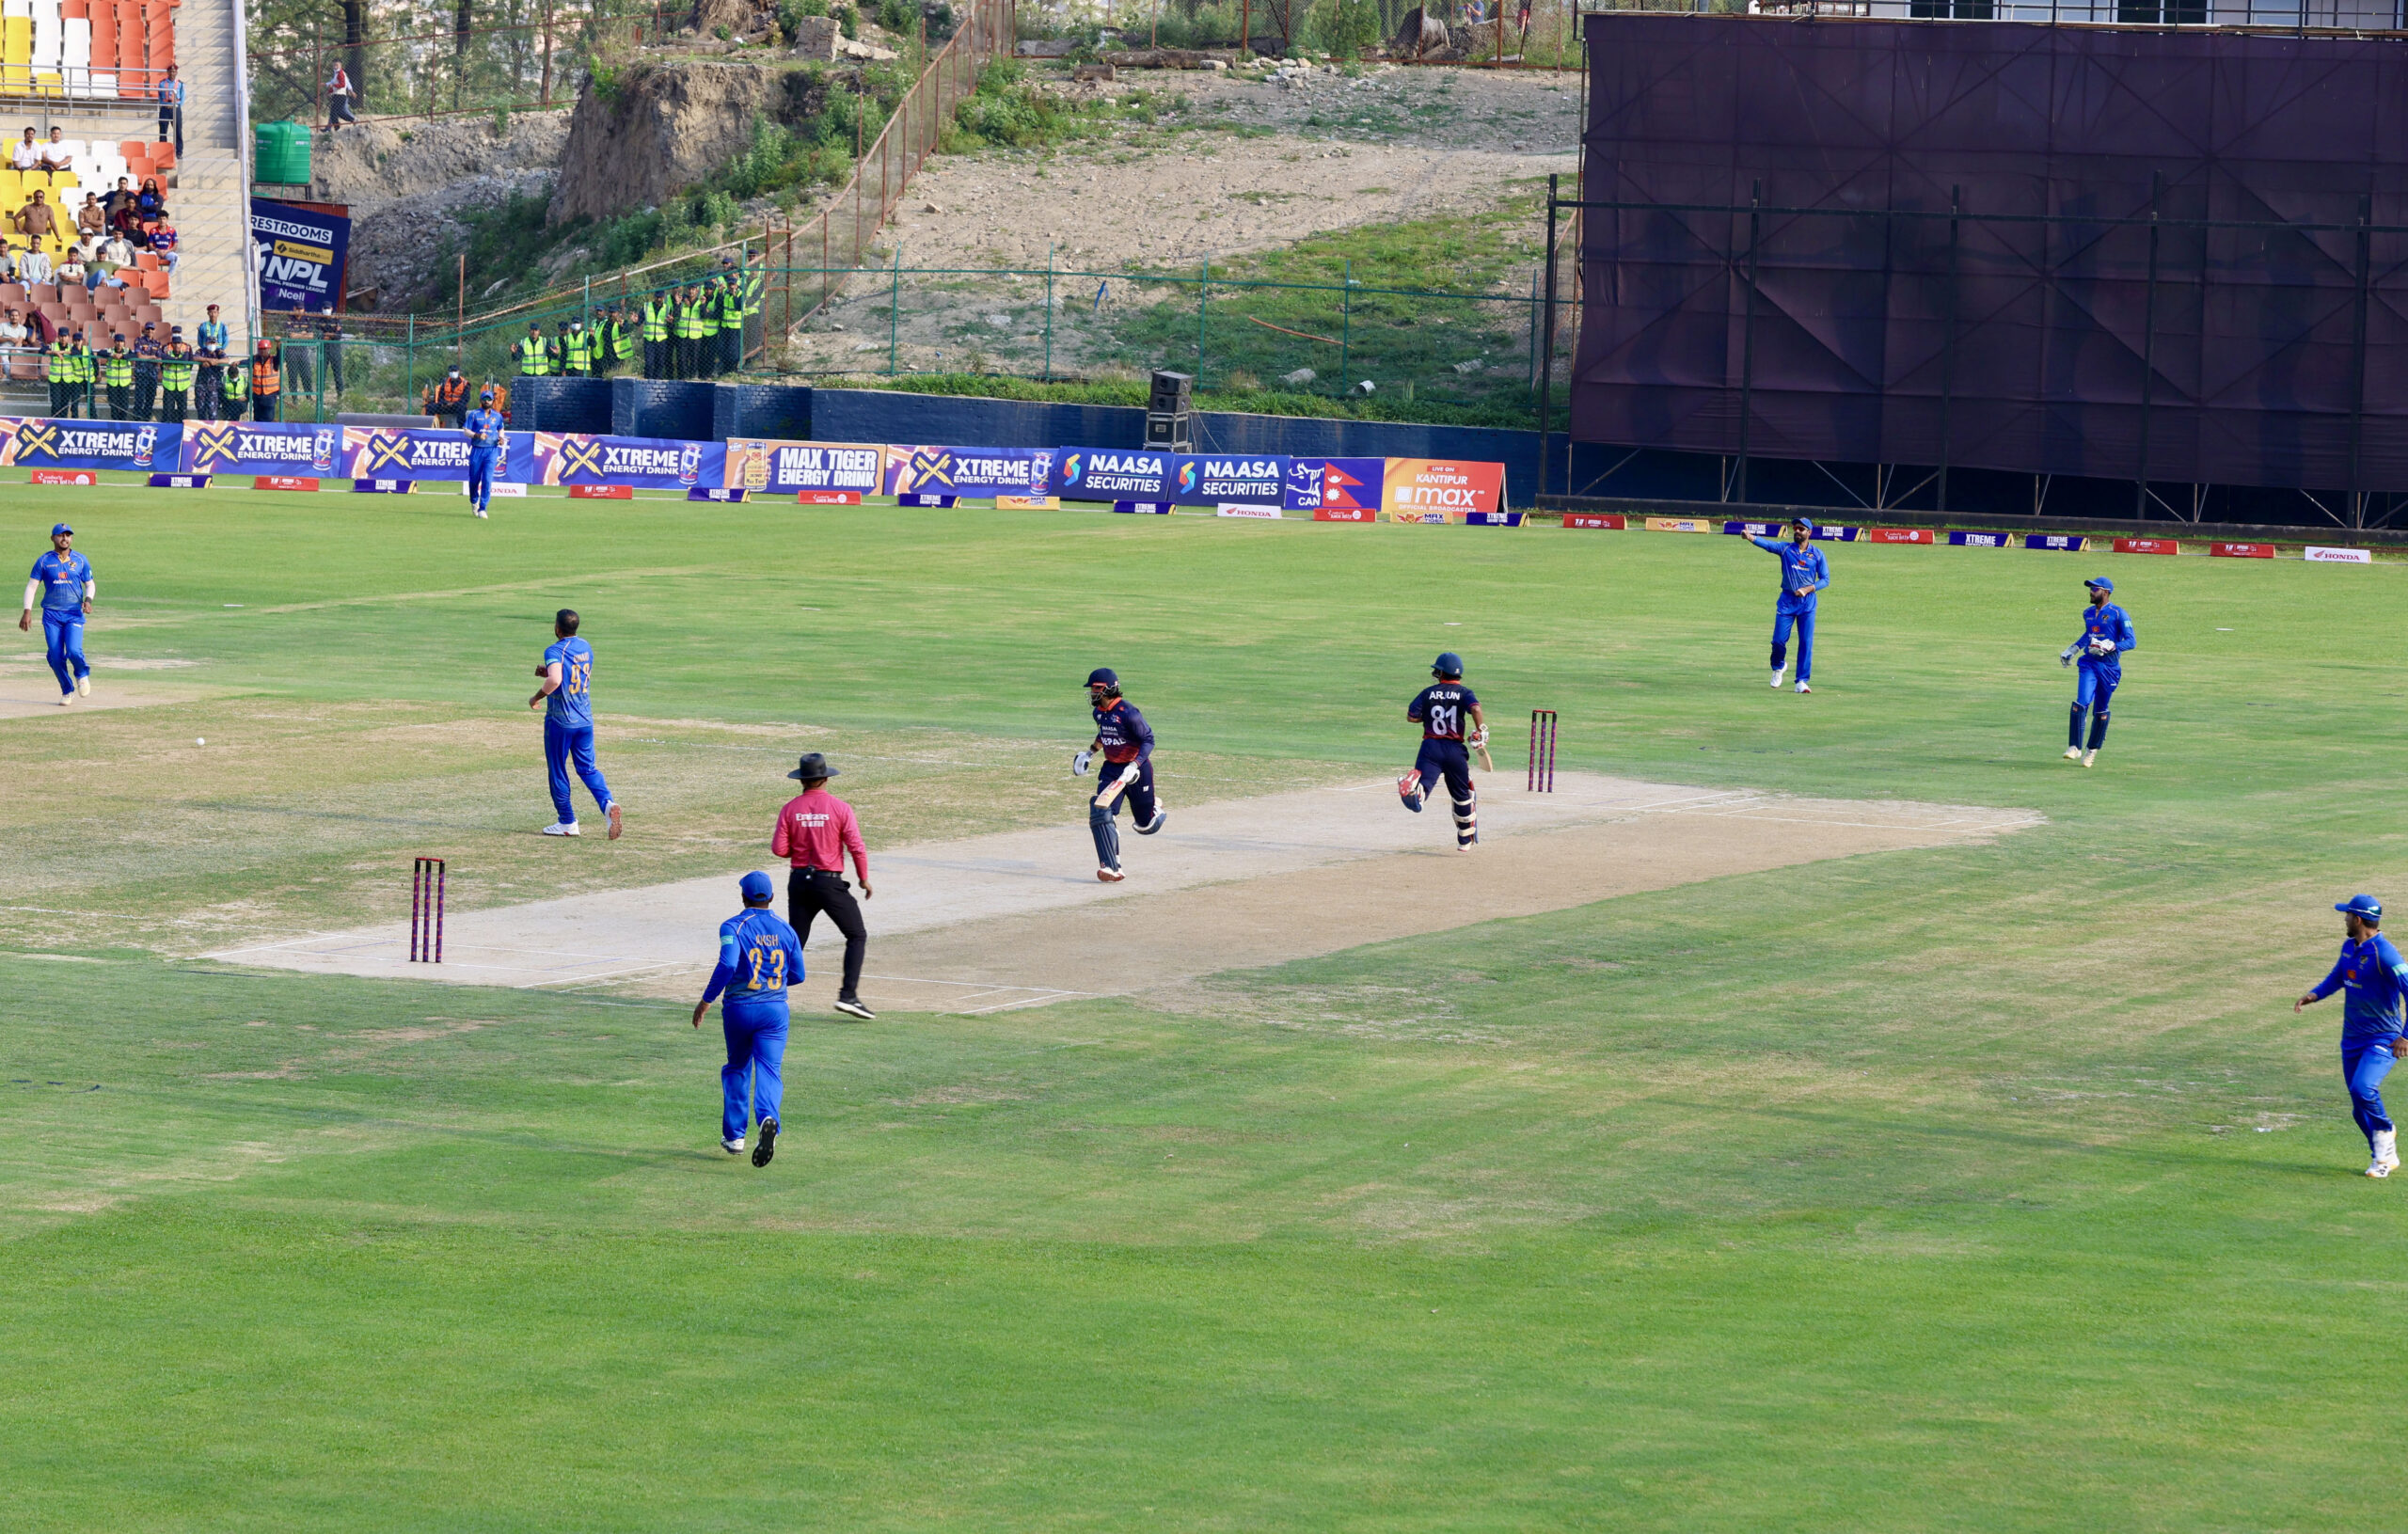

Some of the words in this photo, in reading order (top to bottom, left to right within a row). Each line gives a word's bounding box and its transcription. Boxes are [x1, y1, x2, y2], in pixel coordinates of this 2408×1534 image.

[251, 216, 330, 242] RESTROOMS
[288, 247, 321, 258] Siddhartha
[265, 255, 328, 289] NPL
[279, 288, 305, 301] Ncell
[283, 281, 305, 290] PREMIER
[306, 285, 326, 294] LEAGUE
[60, 431, 134, 450] XTREME
[239, 434, 312, 453] XTREME
[58, 447, 100, 456] ENERGY
[101, 448, 134, 457] DRINK
[237, 451, 280, 460] ENERGY
[281, 452, 313, 461] DRINK
[412, 441, 471, 459] XTREM
[603, 447, 679, 467] XTREME
[780, 447, 821, 470] MAX
[828, 450, 877, 471] TIGER
[411, 456, 452, 466] ENERGY
[602, 465, 645, 474] ENERGY
[646, 466, 679, 475] DRINK
[955, 458, 1029, 477] XTREME
[1089, 454, 1164, 475] NAASA
[1204, 461, 1280, 479] NAASA
[778, 469, 832, 486] ENERGY
[833, 471, 875, 488] DRINK
[953, 475, 995, 484] ENERGY
[997, 476, 1030, 485] DRINK
[1085, 475, 1161, 493] SECURITIES
[1416, 474, 1468, 485] KANTIPUR
[1202, 482, 1278, 496] SECURITIES
[1415, 487, 1476, 506] max
[1298, 497, 1320, 506] CAN
[1966, 533, 1996, 545] XTREME
[1430, 705, 1458, 735] 81
[795, 813, 830, 822] Emirates
[747, 948, 785, 990] 23
